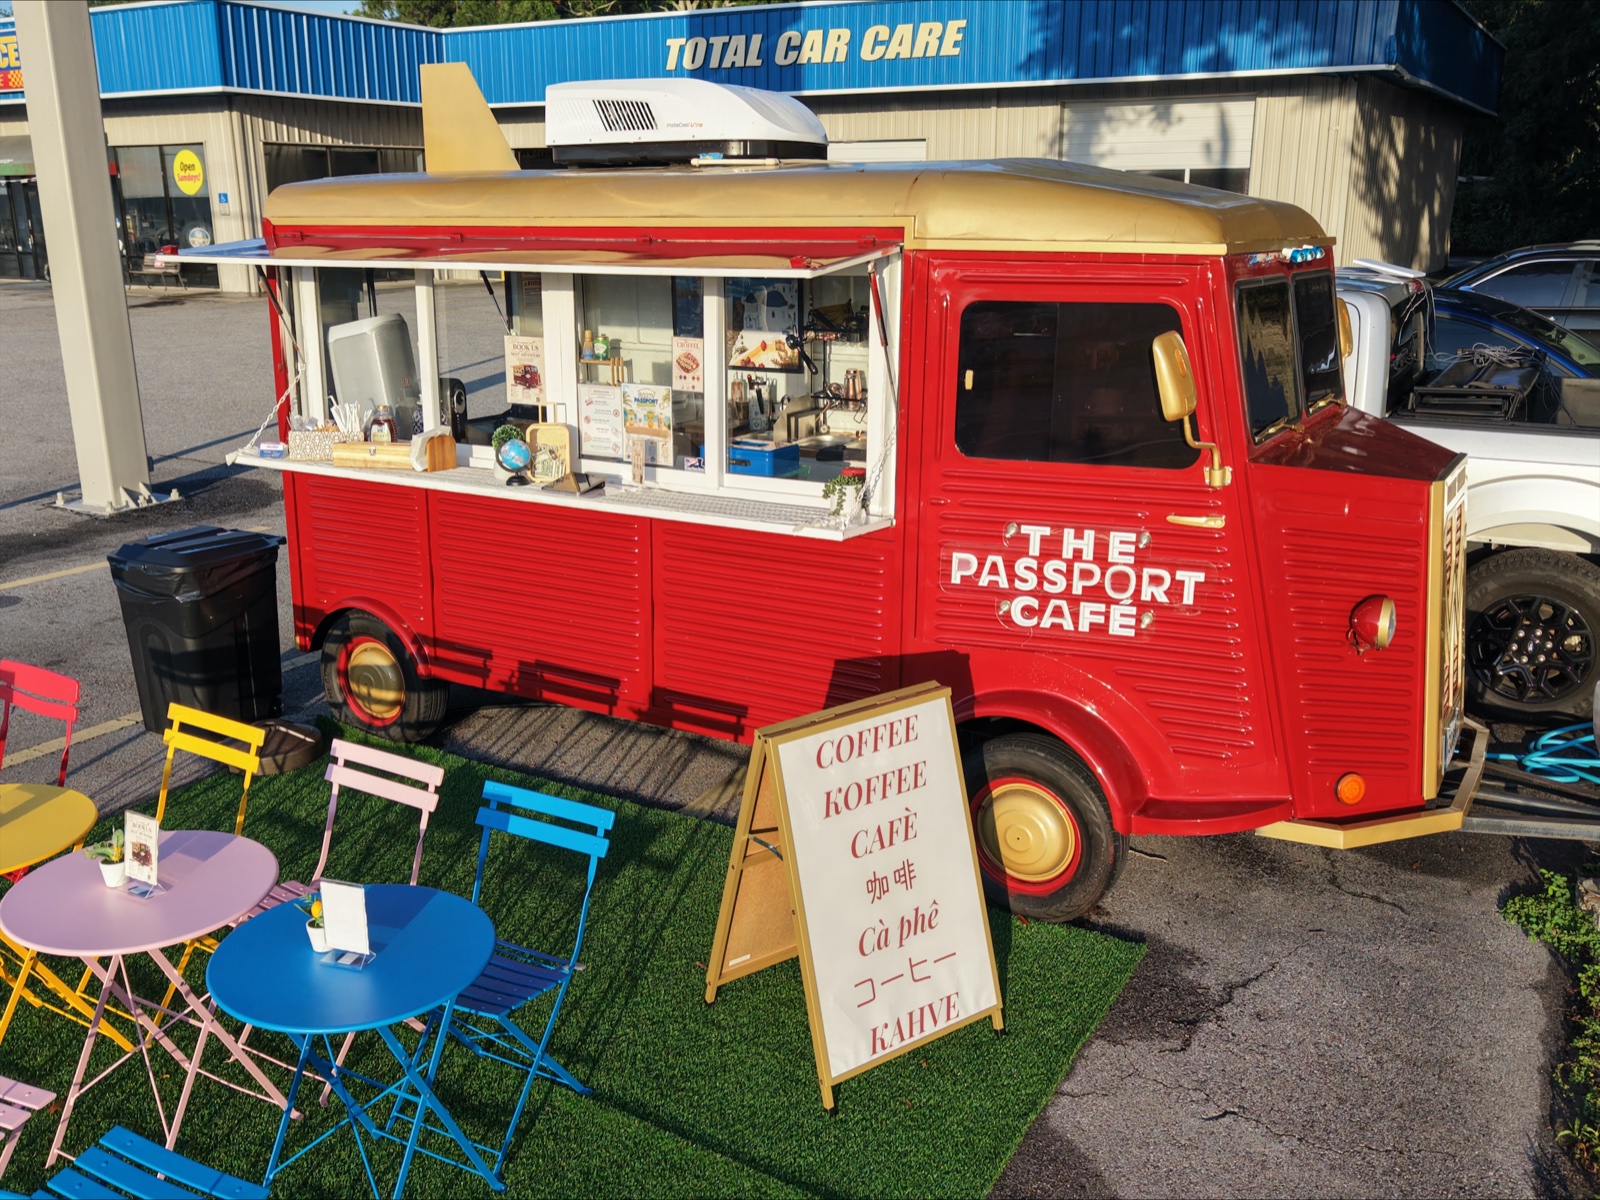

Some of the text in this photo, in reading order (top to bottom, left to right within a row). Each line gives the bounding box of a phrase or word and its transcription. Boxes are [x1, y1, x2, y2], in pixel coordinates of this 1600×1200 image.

[665, 19, 967, 71] TOTAL CAR CARE
[177, 173, 200, 183] Sundays!
[180, 162, 195, 173] Open
[512, 343, 530, 351] BOOK
[1020, 524, 1137, 565] THE
[950, 552, 1206, 606] PASSPORT
[1010, 595, 1137, 637] CAFÉ
[816, 714, 919, 769] COFFEE
[823, 760, 927, 820] KOFFEE
[851, 807, 918, 859] CAFÈ
[866, 859, 917, 904] 咖啡
[858, 899, 939, 957] Cà phê
[854, 952, 957, 1008] コーヒー
[870, 992, 960, 1056] KAHVE
